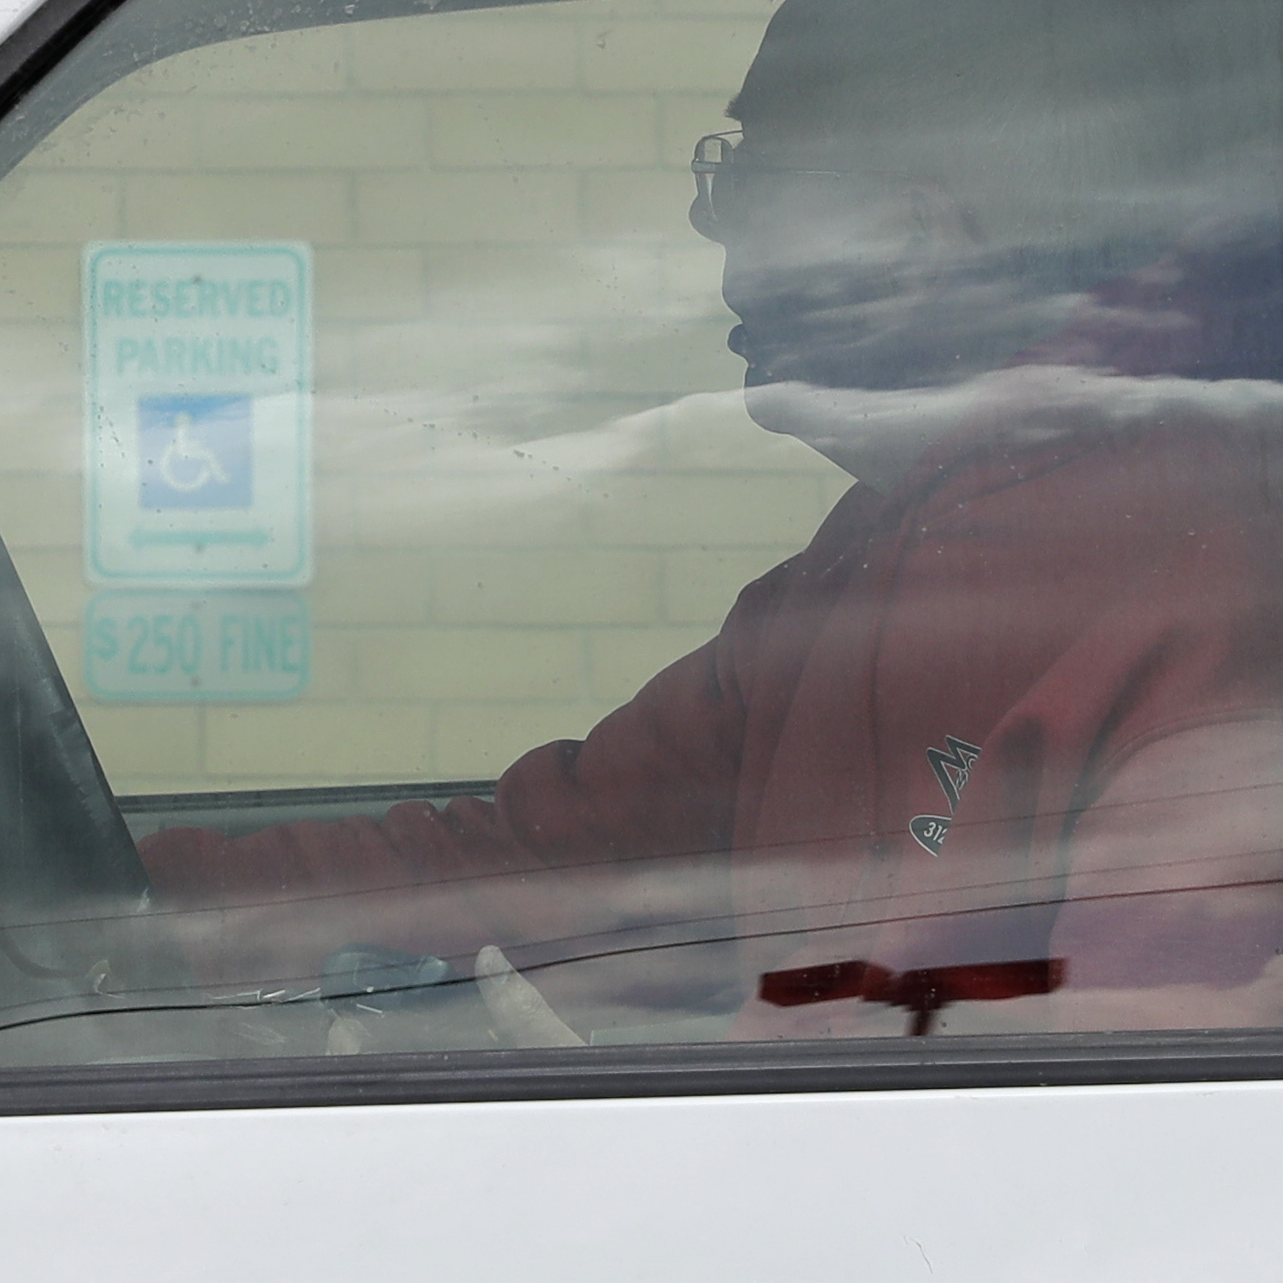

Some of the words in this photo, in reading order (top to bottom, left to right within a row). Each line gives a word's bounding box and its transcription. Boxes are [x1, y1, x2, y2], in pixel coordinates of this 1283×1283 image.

[101, 278, 293, 317] RESERVED
[115, 336, 280, 375] PARKING
[93, 616, 203, 675] $250
[220, 616, 301, 675] FINE
